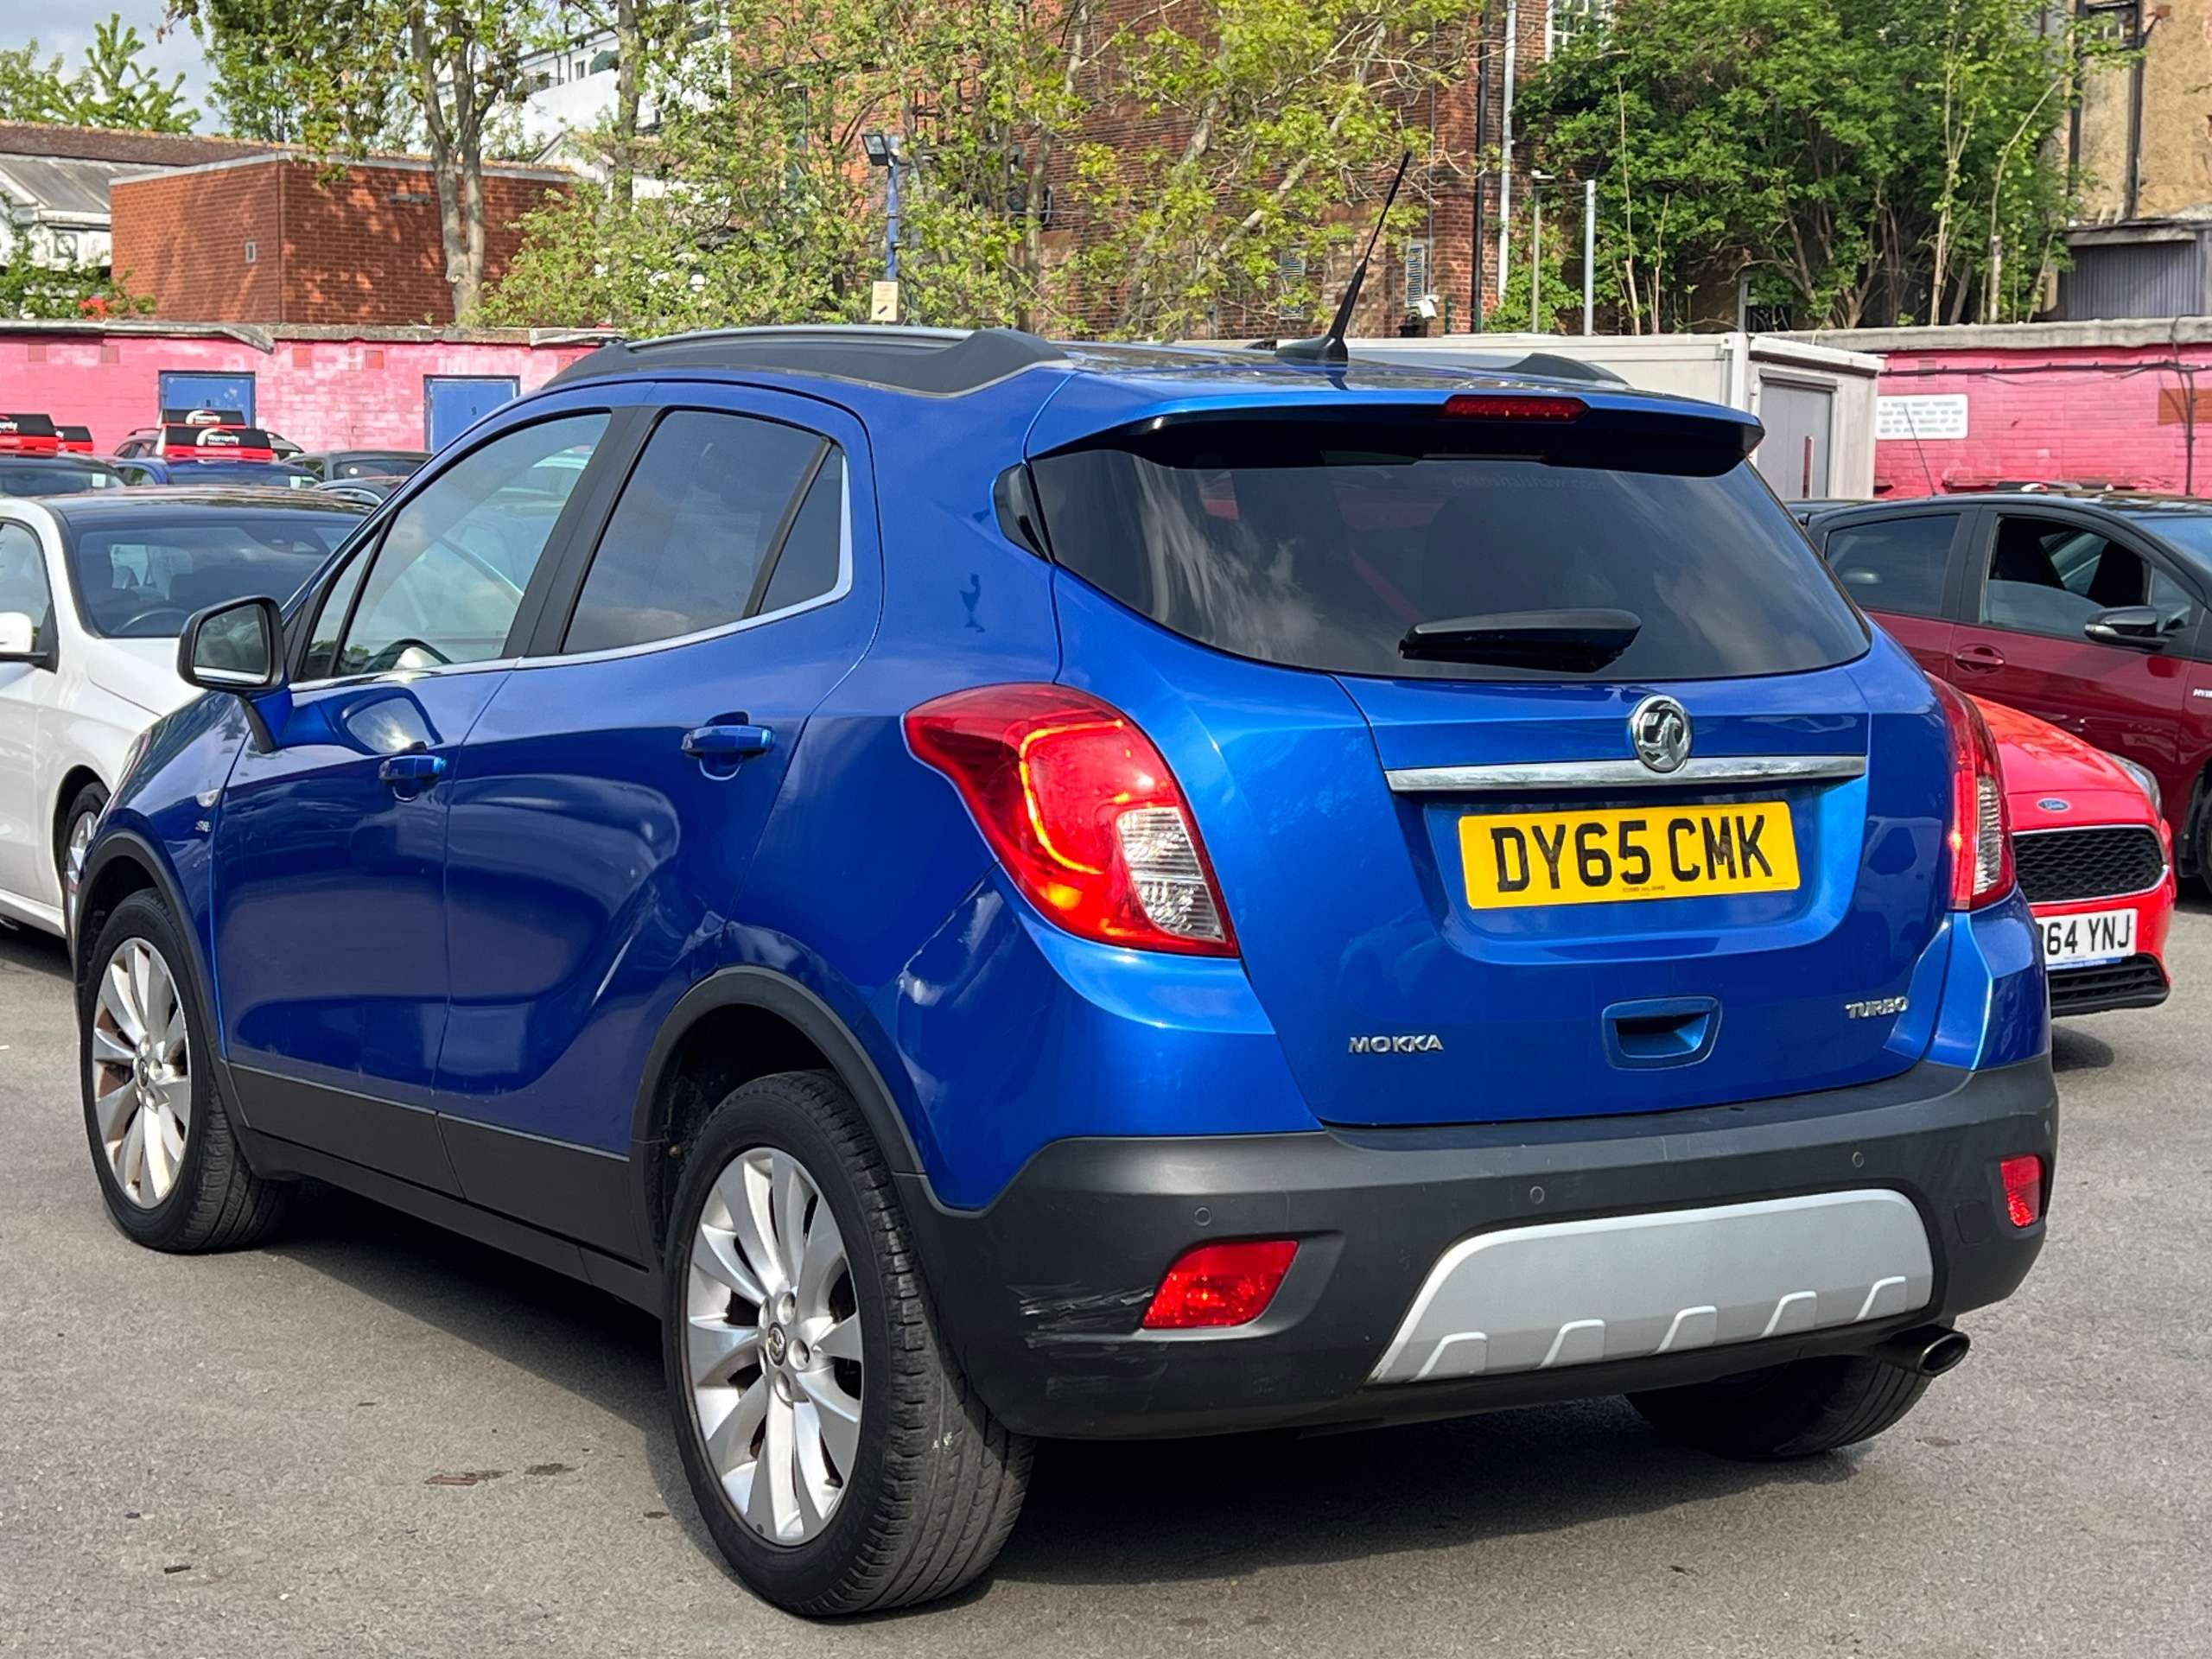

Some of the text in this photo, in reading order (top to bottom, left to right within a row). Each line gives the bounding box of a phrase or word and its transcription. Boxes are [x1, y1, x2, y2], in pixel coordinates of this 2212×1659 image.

[1491, 815, 1772, 893] DY65 CMK
[2088, 914, 2131, 951] YNJ
[1845, 995, 1910, 1019] TURBO
[1348, 1034, 1444, 1053] MOKKA
